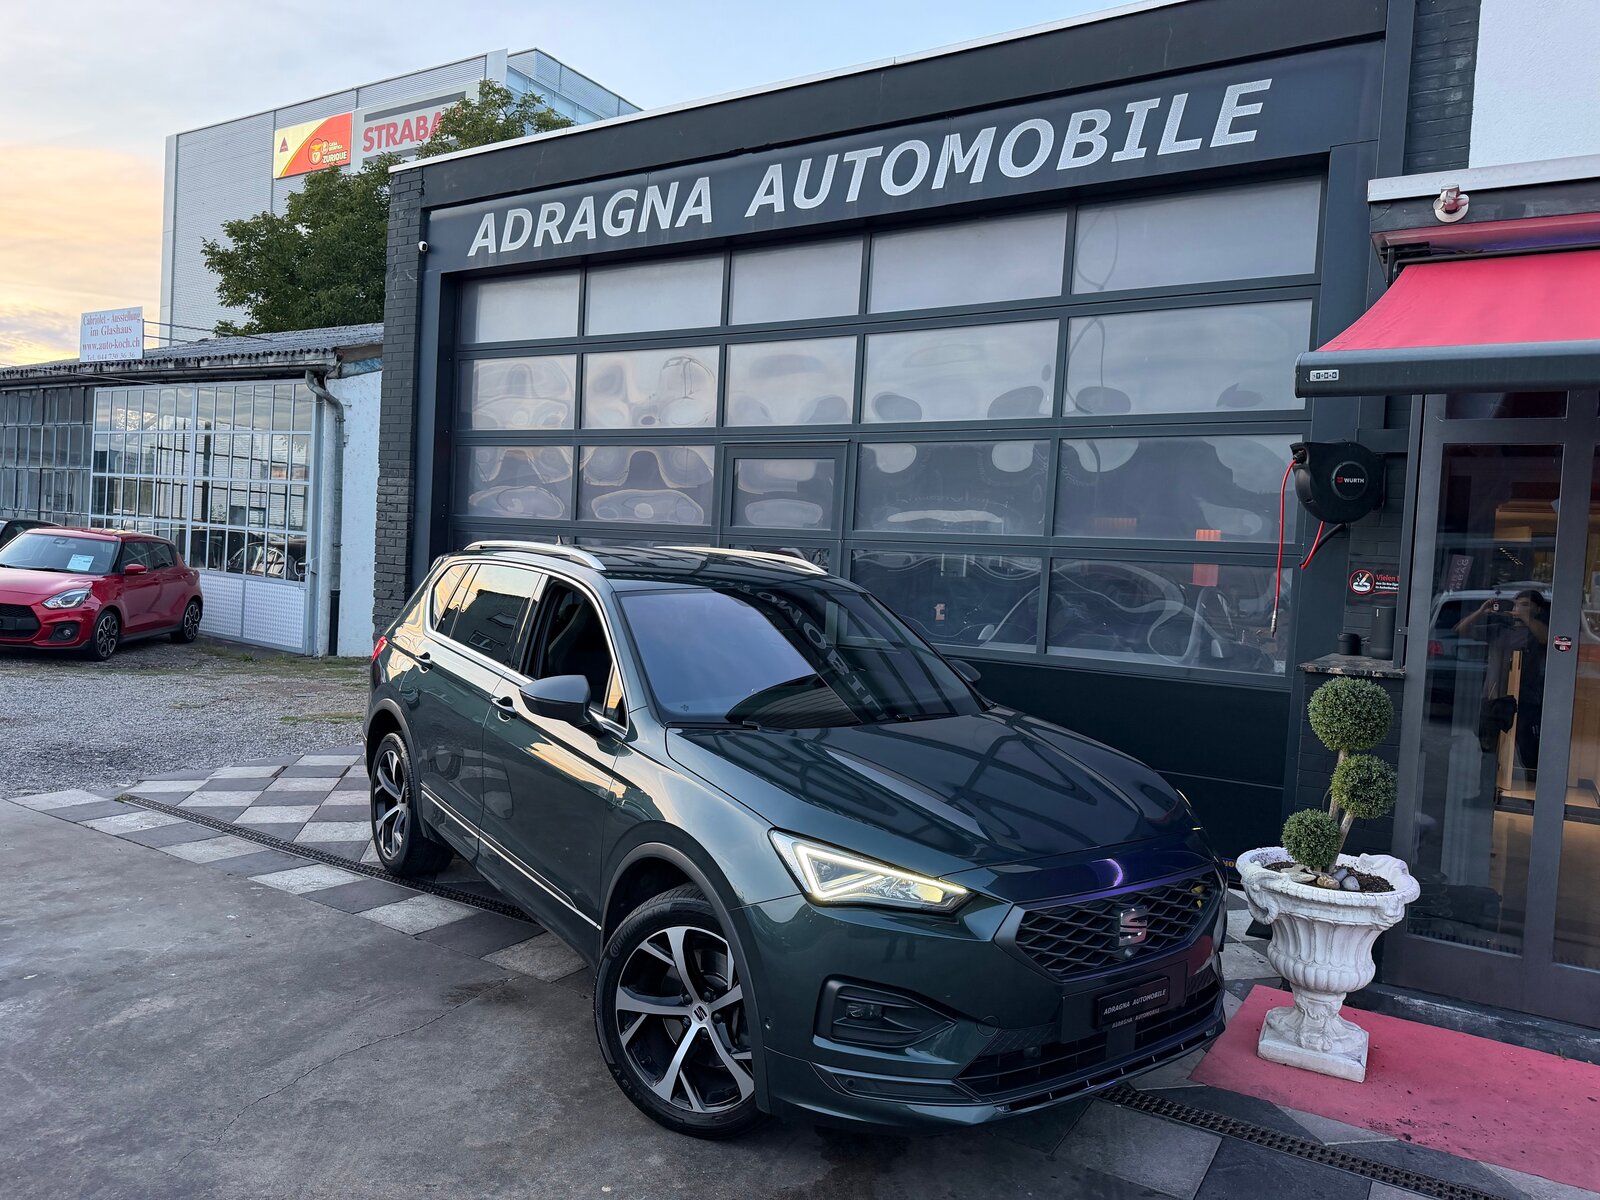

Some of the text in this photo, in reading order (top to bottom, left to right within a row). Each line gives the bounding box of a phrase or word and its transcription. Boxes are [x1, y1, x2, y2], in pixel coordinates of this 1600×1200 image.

[362, 111, 443, 152] STRABA
[322, 151, 348, 164] ZURIQUE
[467, 78, 1272, 256] ADRAGNA AUTOMOBILE
[90, 324, 133, 337] im Glashaus
[82, 336, 140, 351] www.auto-koch.ch
[1376, 574, 1396, 582] Vielen
[1103, 989, 1167, 1015] ADRAGNA AUTOMOBILE
